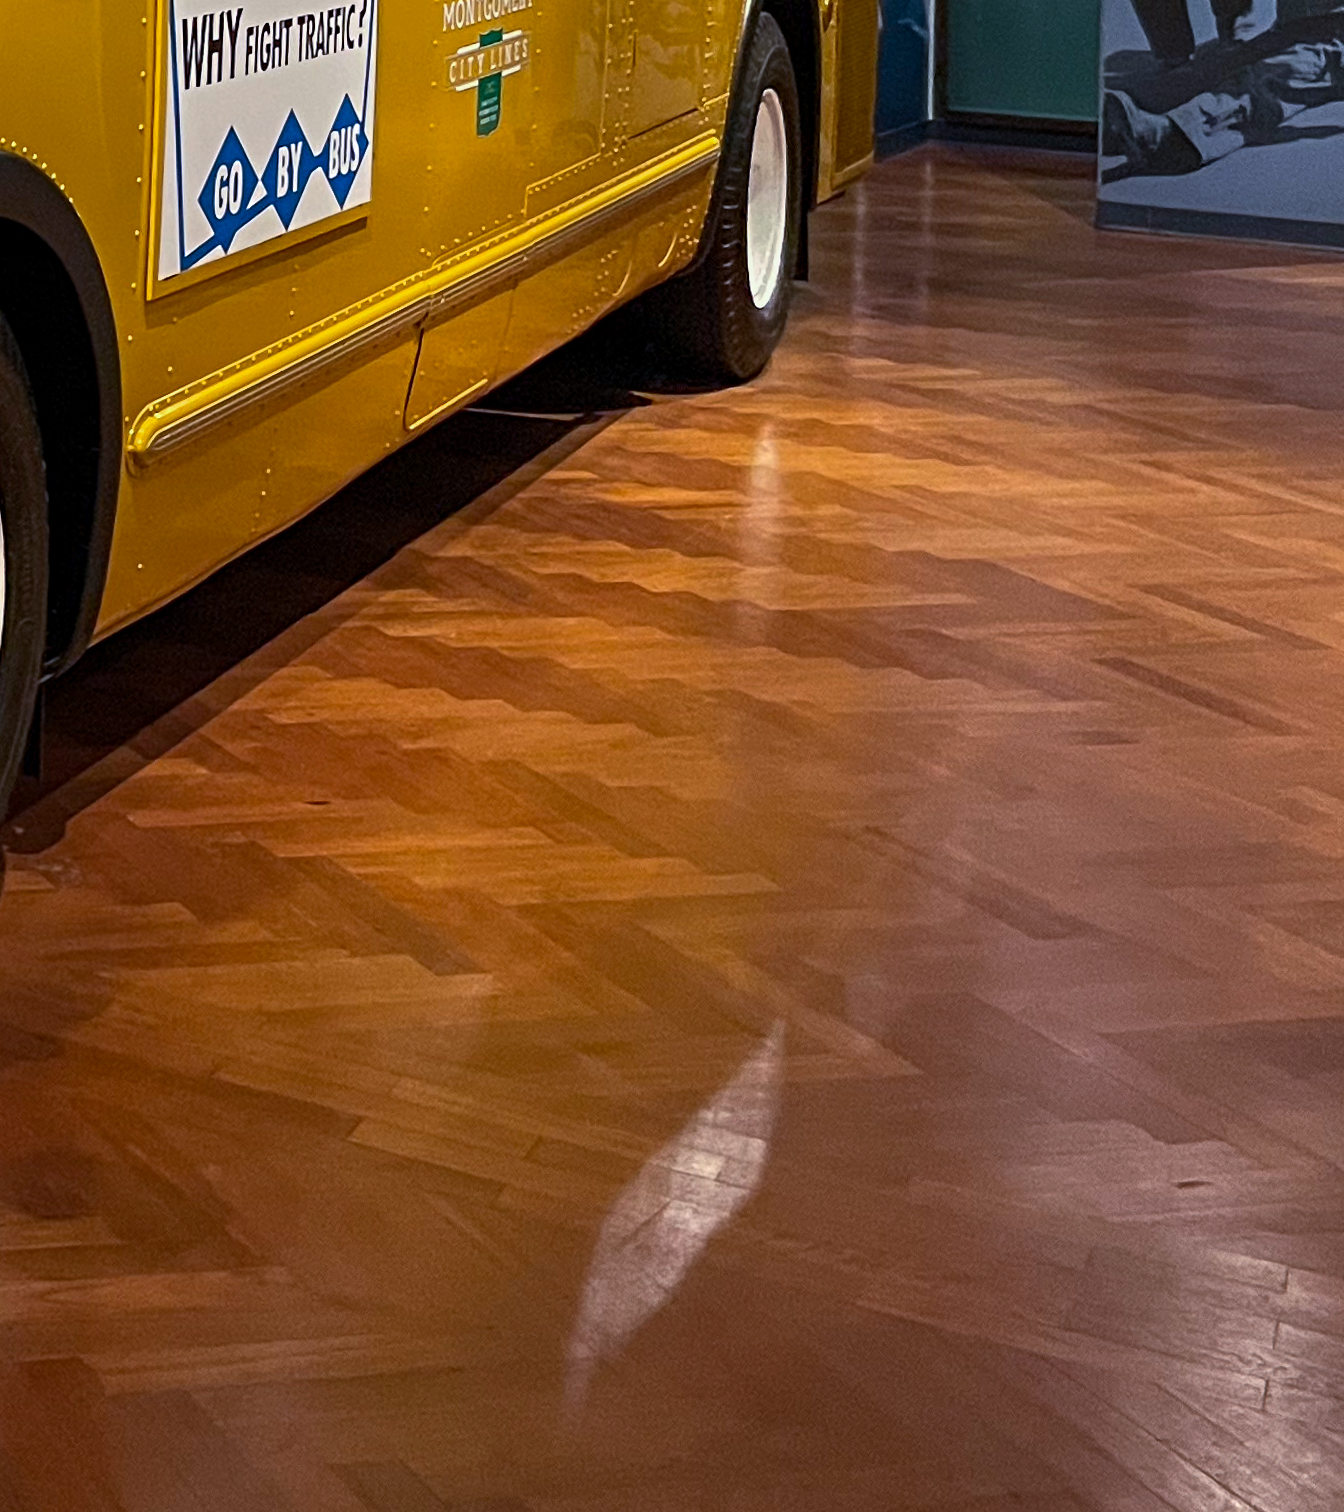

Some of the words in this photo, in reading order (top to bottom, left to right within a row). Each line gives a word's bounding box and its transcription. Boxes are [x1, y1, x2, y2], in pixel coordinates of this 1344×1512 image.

[182, 7, 243, 90] WHY
[245, 17, 293, 76] FIGHT
[449, 52, 485, 83] CITY
[490, 38, 528, 70] LINES
[214, 160, 243, 220] GO
[276, 140, 303, 198] BY
[328, 123, 360, 179] BUS
